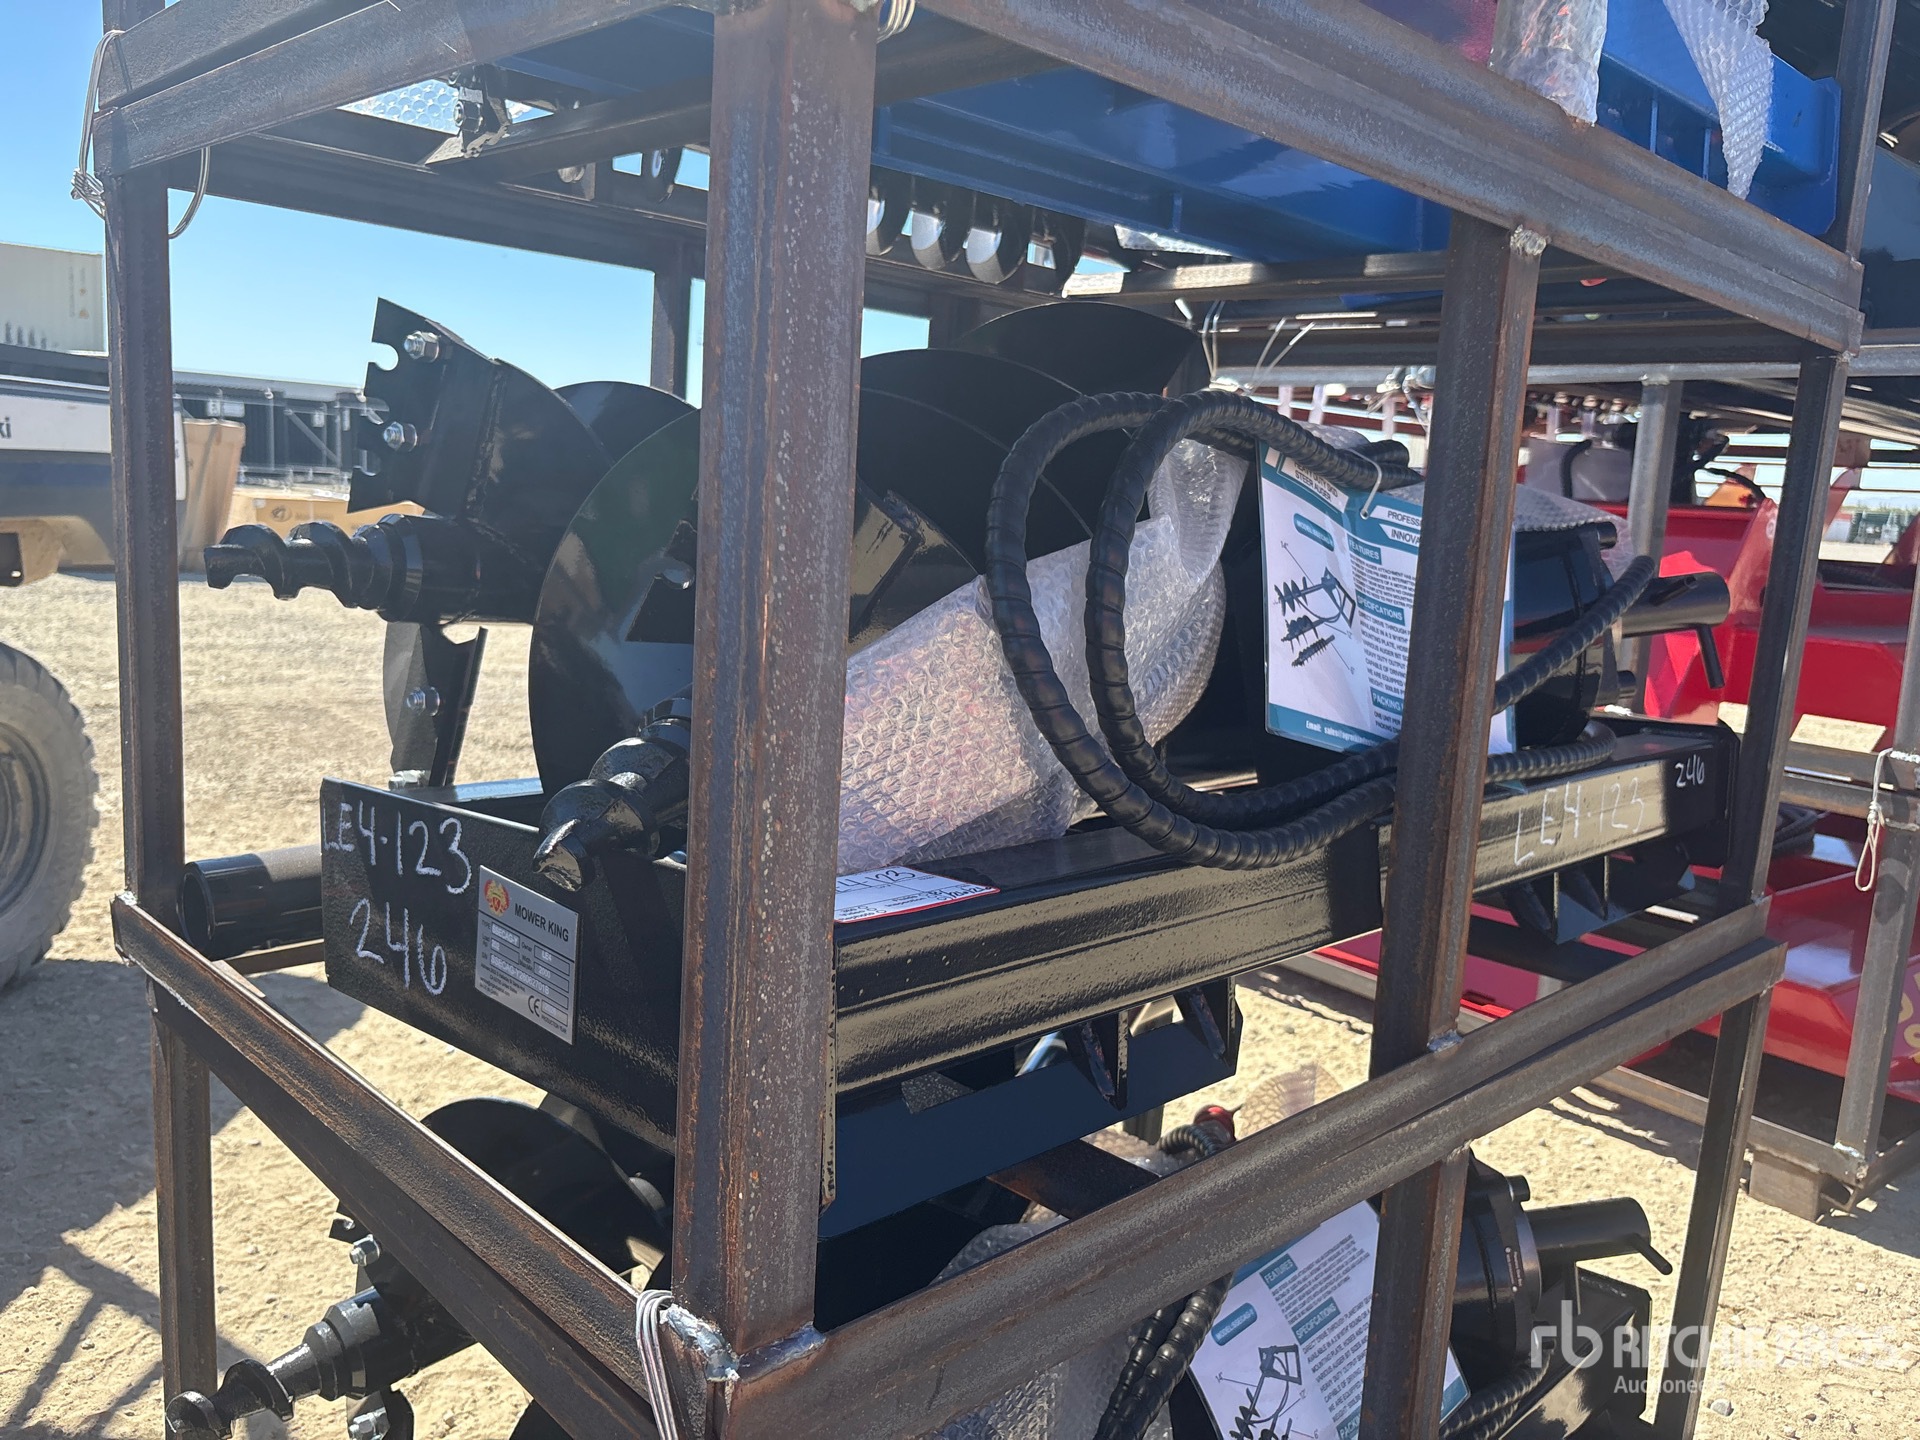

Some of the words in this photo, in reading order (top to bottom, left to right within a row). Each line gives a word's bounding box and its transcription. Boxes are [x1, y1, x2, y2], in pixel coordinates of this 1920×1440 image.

[1294, 470, 1314, 489] STEER
[1388, 510, 1422, 526] PROFESS
[1391, 529, 1420, 547] INNOVA
[1675, 754, 1705, 788] 246
[515, 903, 546, 930] MOWER
[548, 921, 569, 942] KING
[350, 898, 447, 996] 246
[1264, 1259, 1294, 1284] FEATURES
